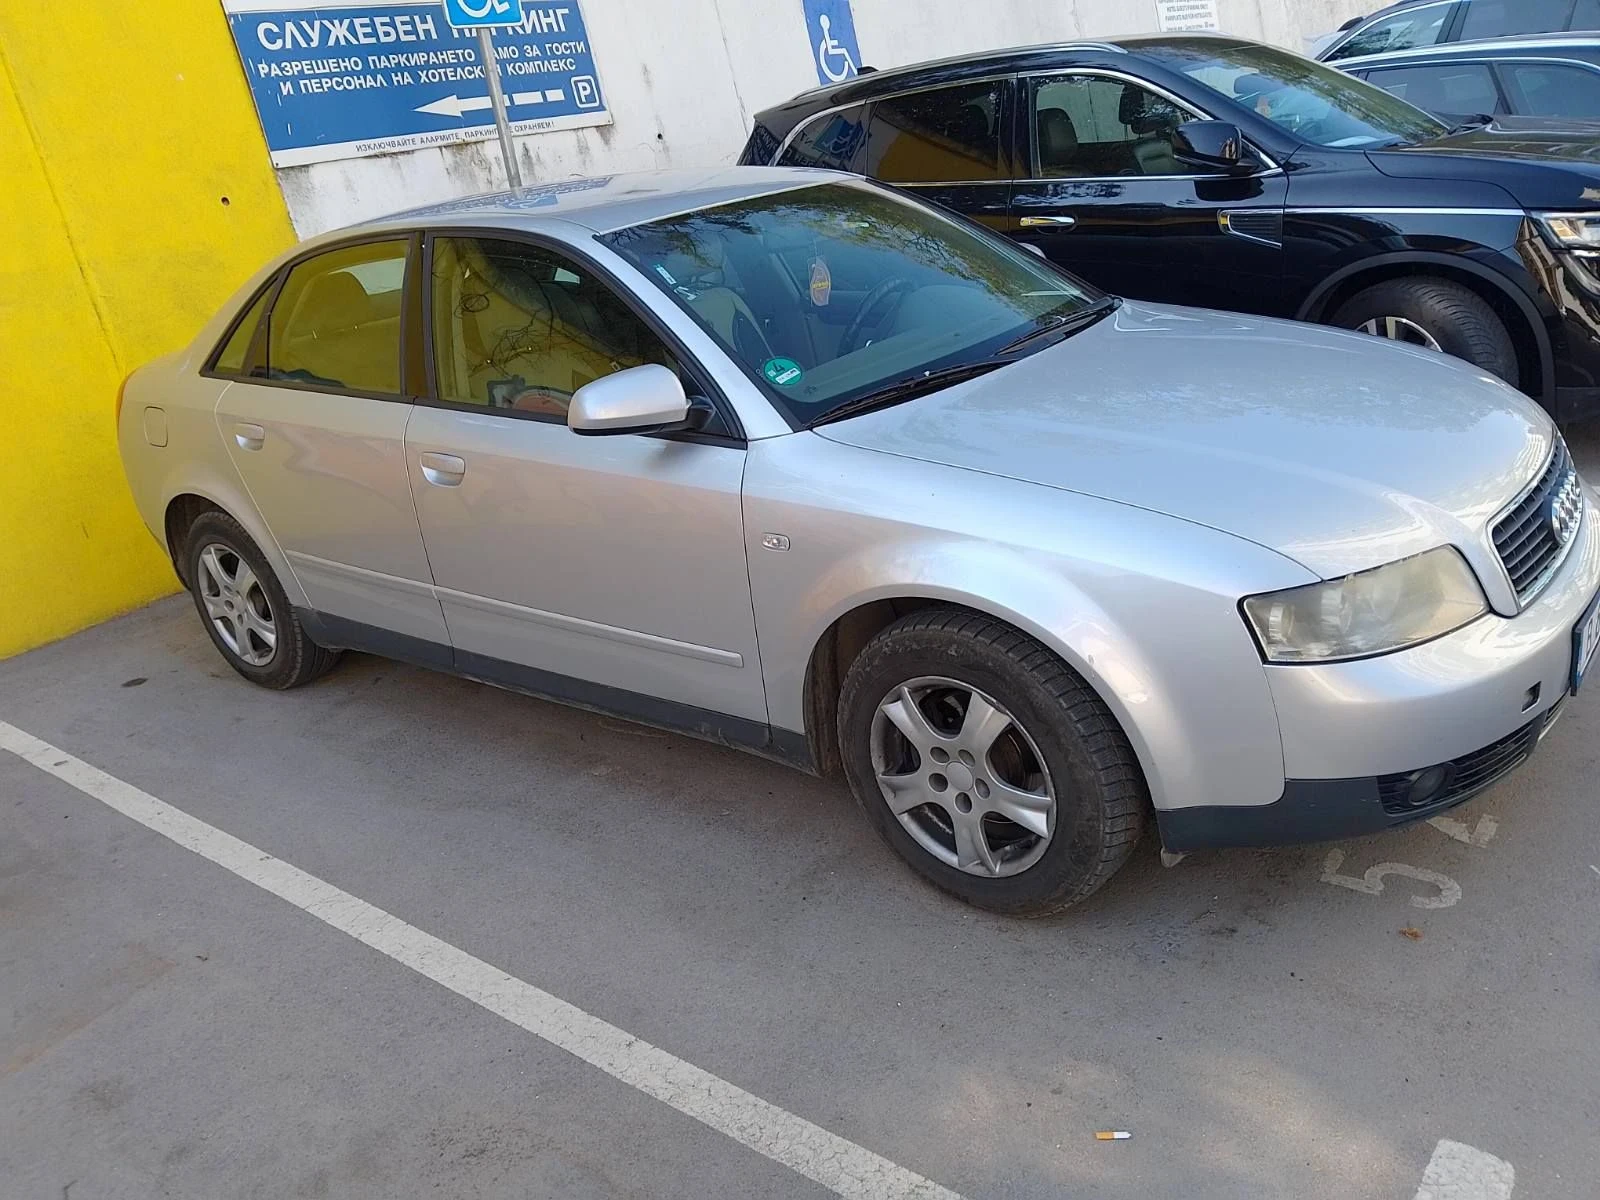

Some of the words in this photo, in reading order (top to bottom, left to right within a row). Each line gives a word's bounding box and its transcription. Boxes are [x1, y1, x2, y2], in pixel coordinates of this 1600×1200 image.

[257, 15, 438, 51] СЛУЖЕБЕН
[257, 56, 362, 78] РАЗРЕШЕНО
[368, 49, 476, 70] ПАРКИРАНЕТО
[492, 45, 519, 60] АМО
[523, 45, 542, 58] ЗА
[545, 41, 586, 56] ГОСТИ
[279, 80, 294, 96] И
[299, 74, 387, 95] ПЕРСОНАЛ
[391, 72, 414, 86] НА
[418, 63, 503, 84] ХОТЕЛСК
[505, 58, 577, 76] КОМПЛЕКС
[577, 81, 591, 103] P
[355, 137, 417, 152] ИЗКЛЮЧВАЙТЕ
